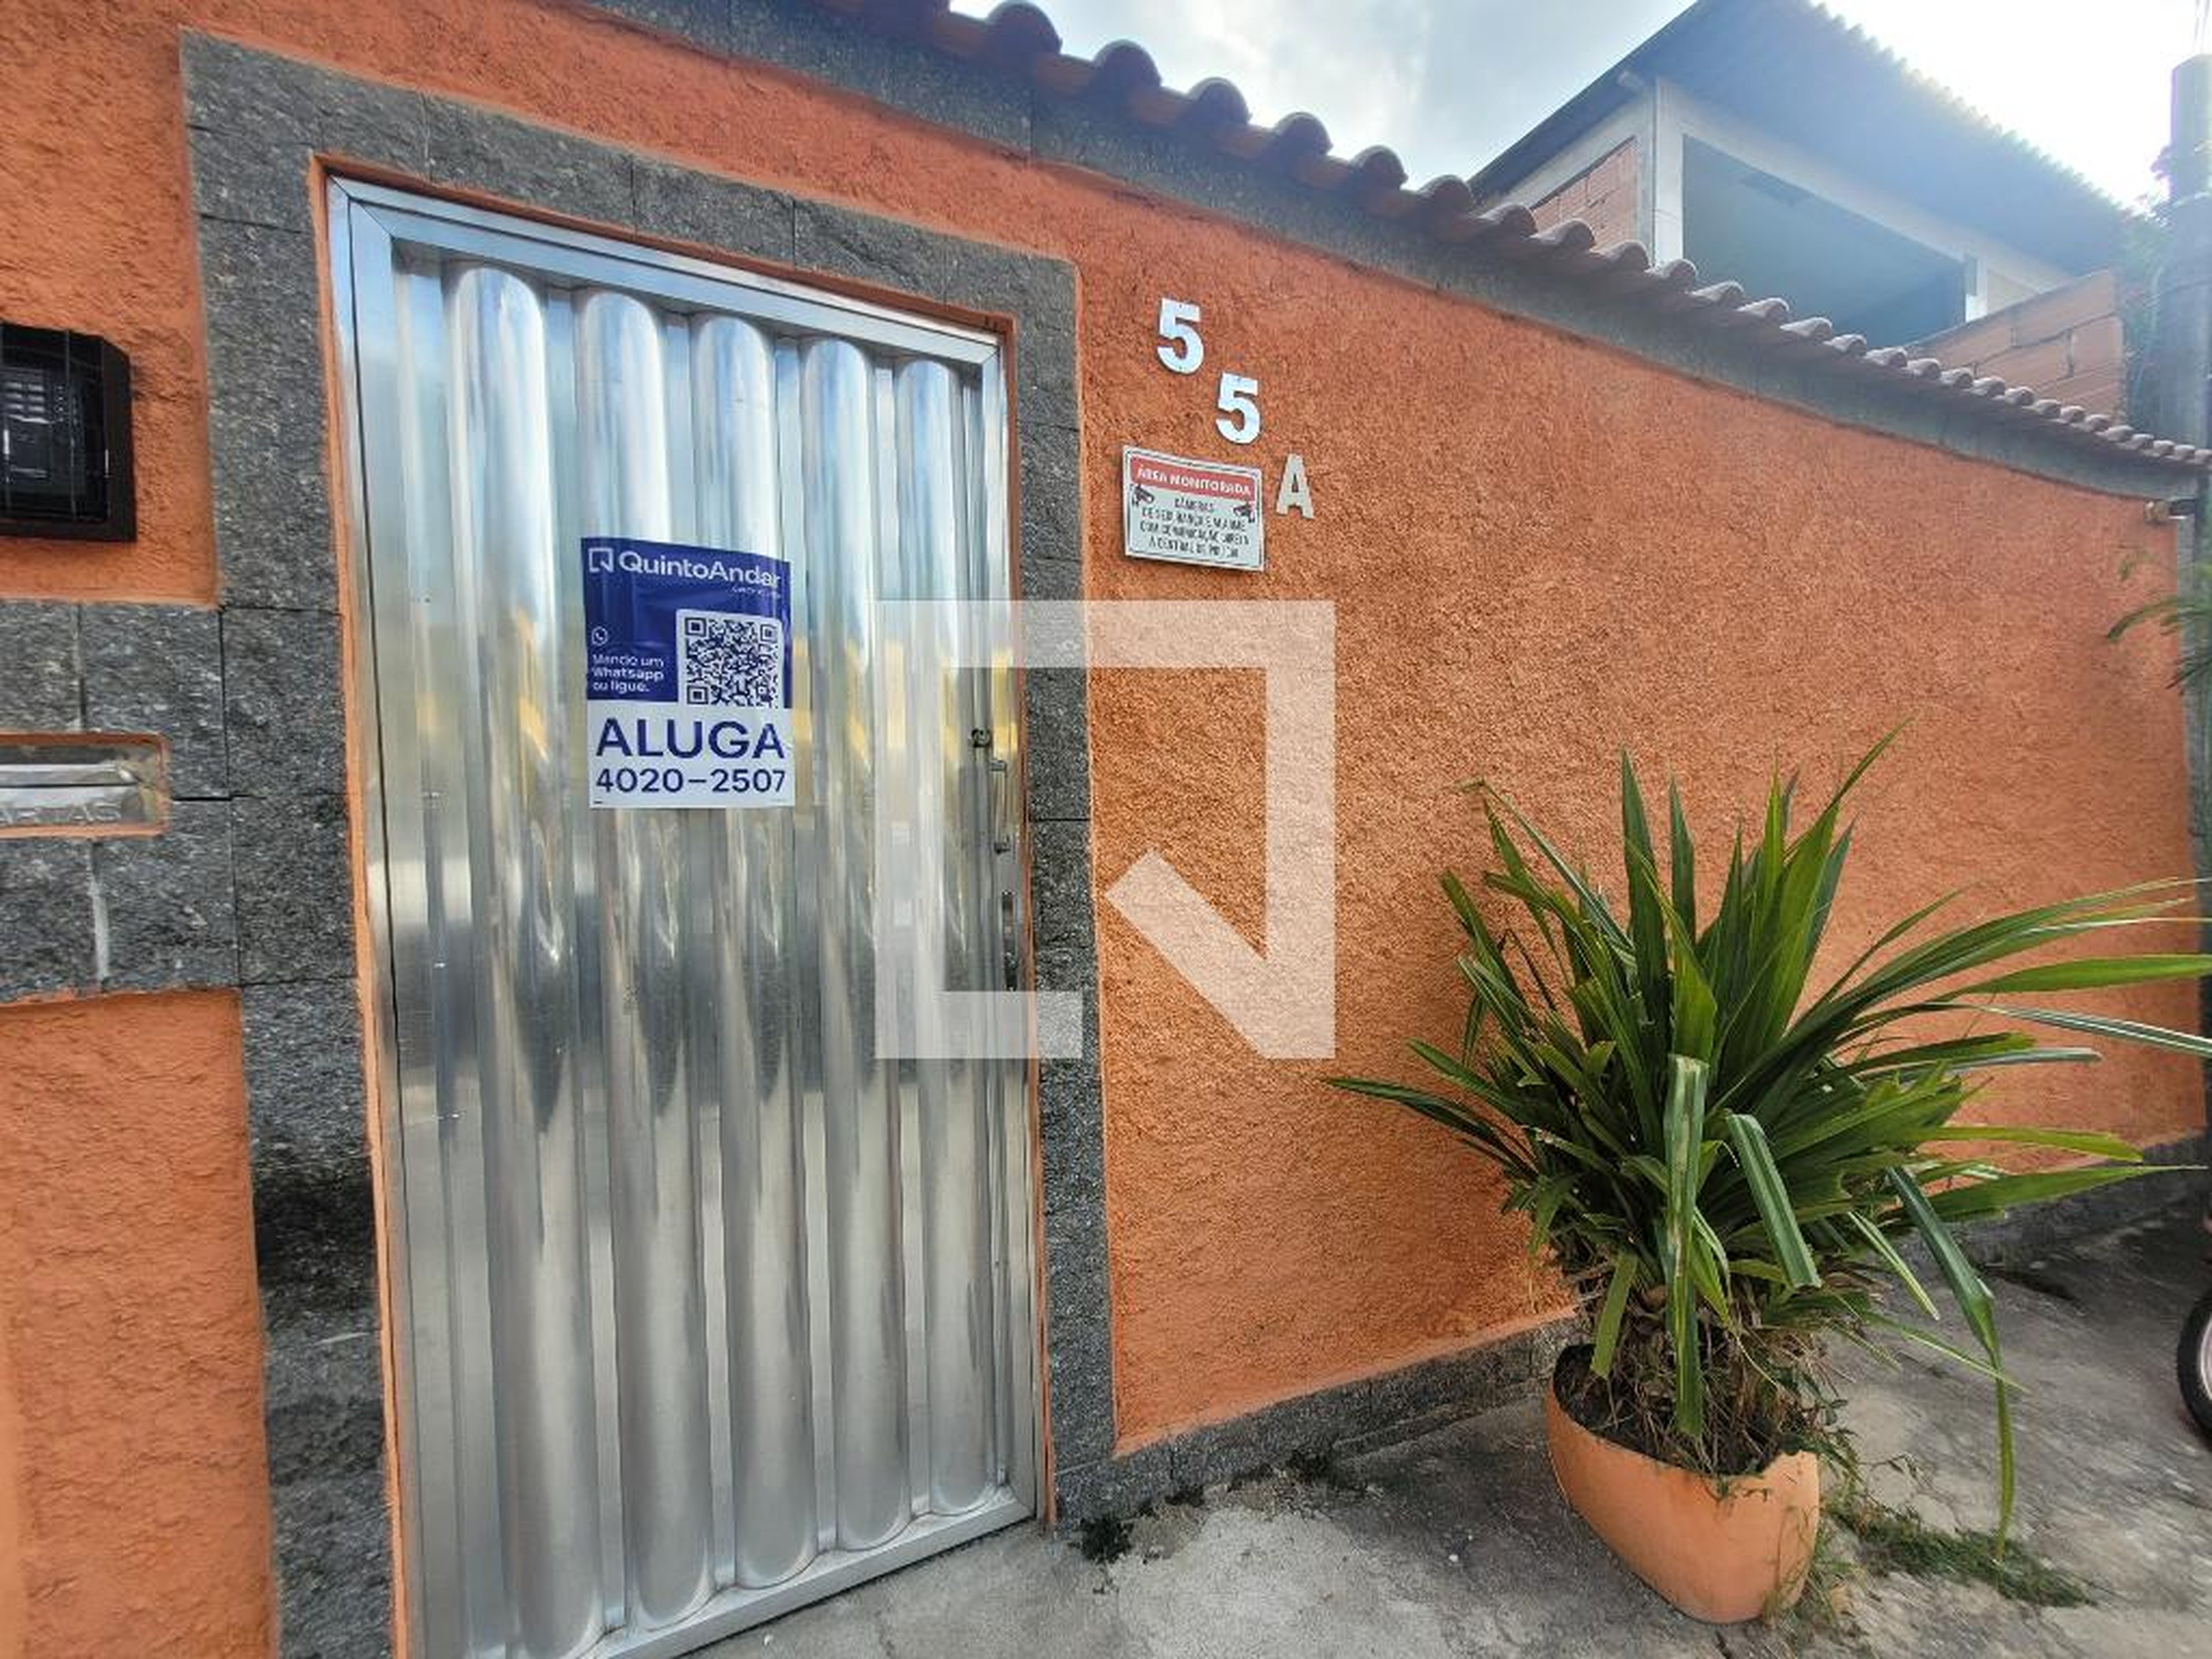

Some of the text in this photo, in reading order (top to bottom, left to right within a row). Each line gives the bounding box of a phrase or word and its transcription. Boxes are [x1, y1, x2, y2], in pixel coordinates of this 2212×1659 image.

[1157, 298, 1205, 374] 5
[1215, 372, 1262, 445] 5
[619, 551, 781, 588] QuintoAndar
[596, 717, 785, 759] ALUGA
[596, 767, 786, 793] 4020-2507
